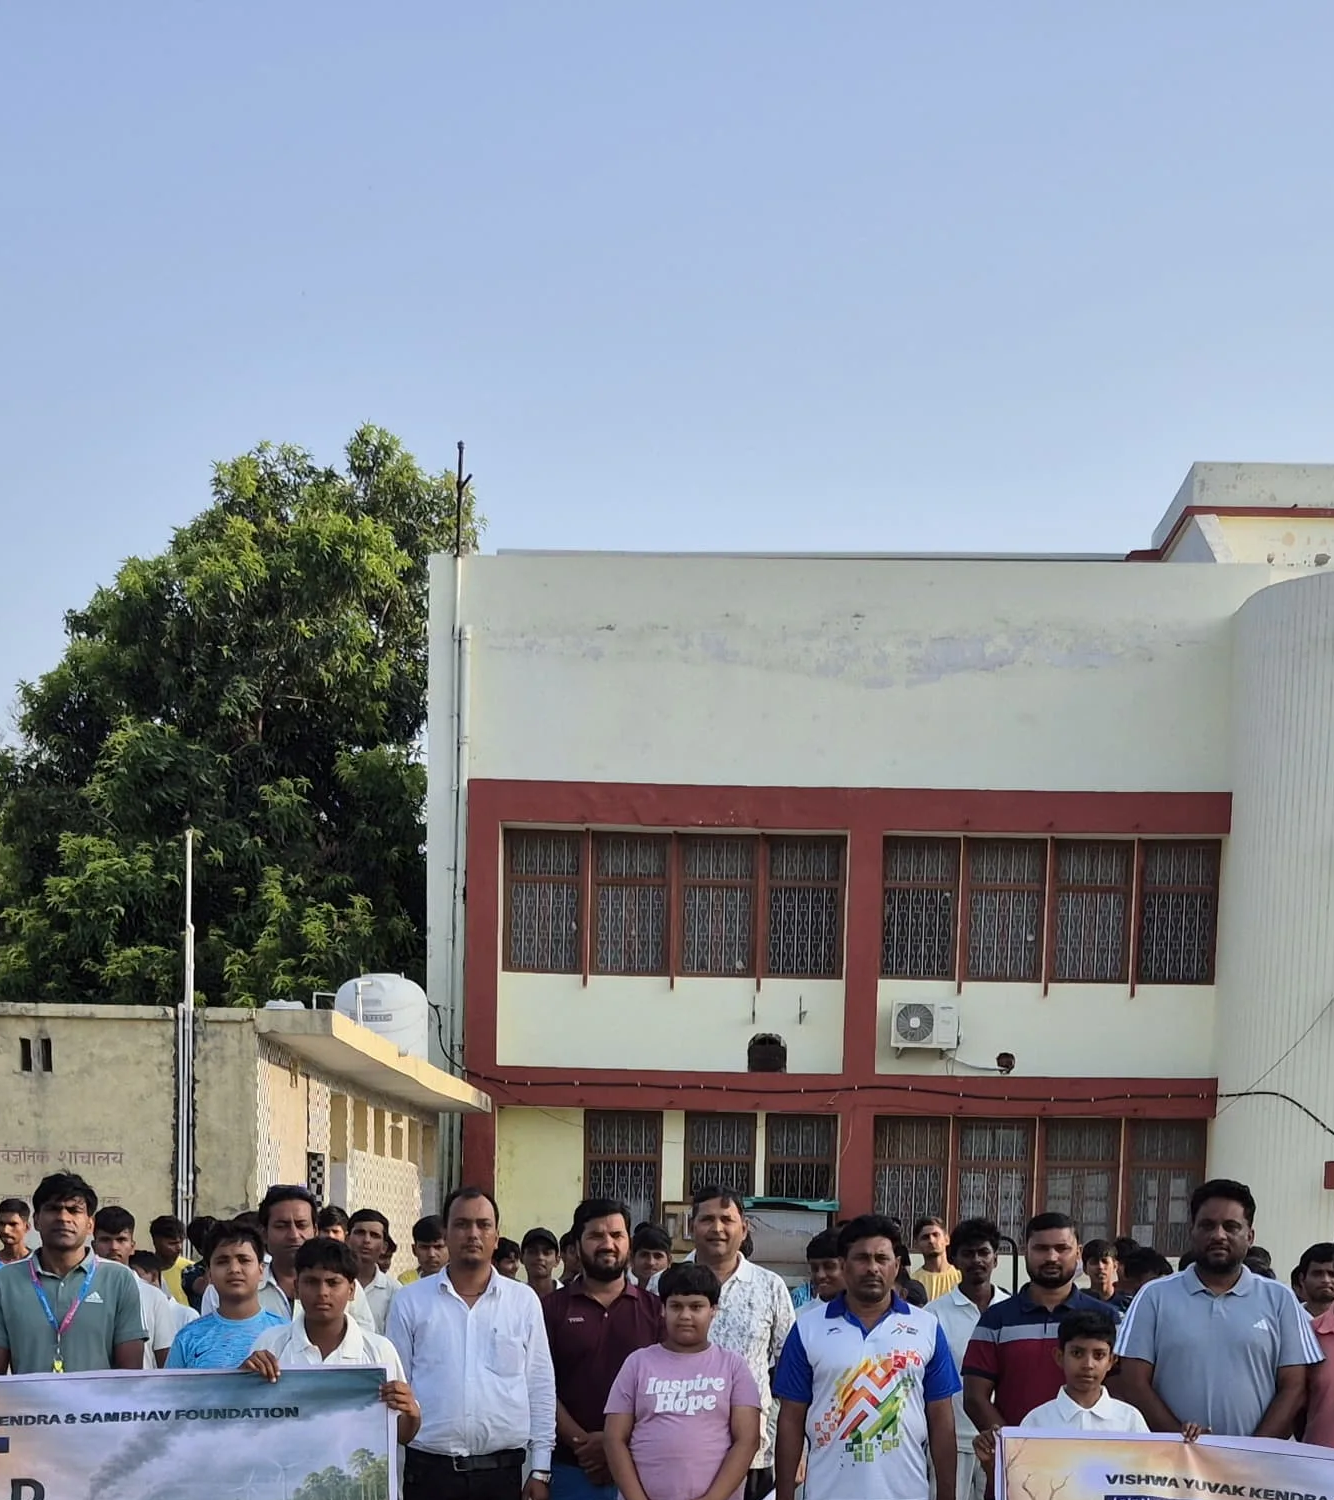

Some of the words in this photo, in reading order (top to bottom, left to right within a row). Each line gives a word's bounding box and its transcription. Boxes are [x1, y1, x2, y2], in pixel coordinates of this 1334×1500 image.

[645, 1373, 725, 1397] Inspire
[64, 1413, 77, 1424] &
[80, 1410, 171, 1424] SAMBHAV
[175, 1406, 299, 1420] FOUNDATION
[654, 1392, 716, 1415] Hope
[1105, 1474, 1180, 1489] VISHWA
[1183, 1478, 1245, 1497] YUVAK
